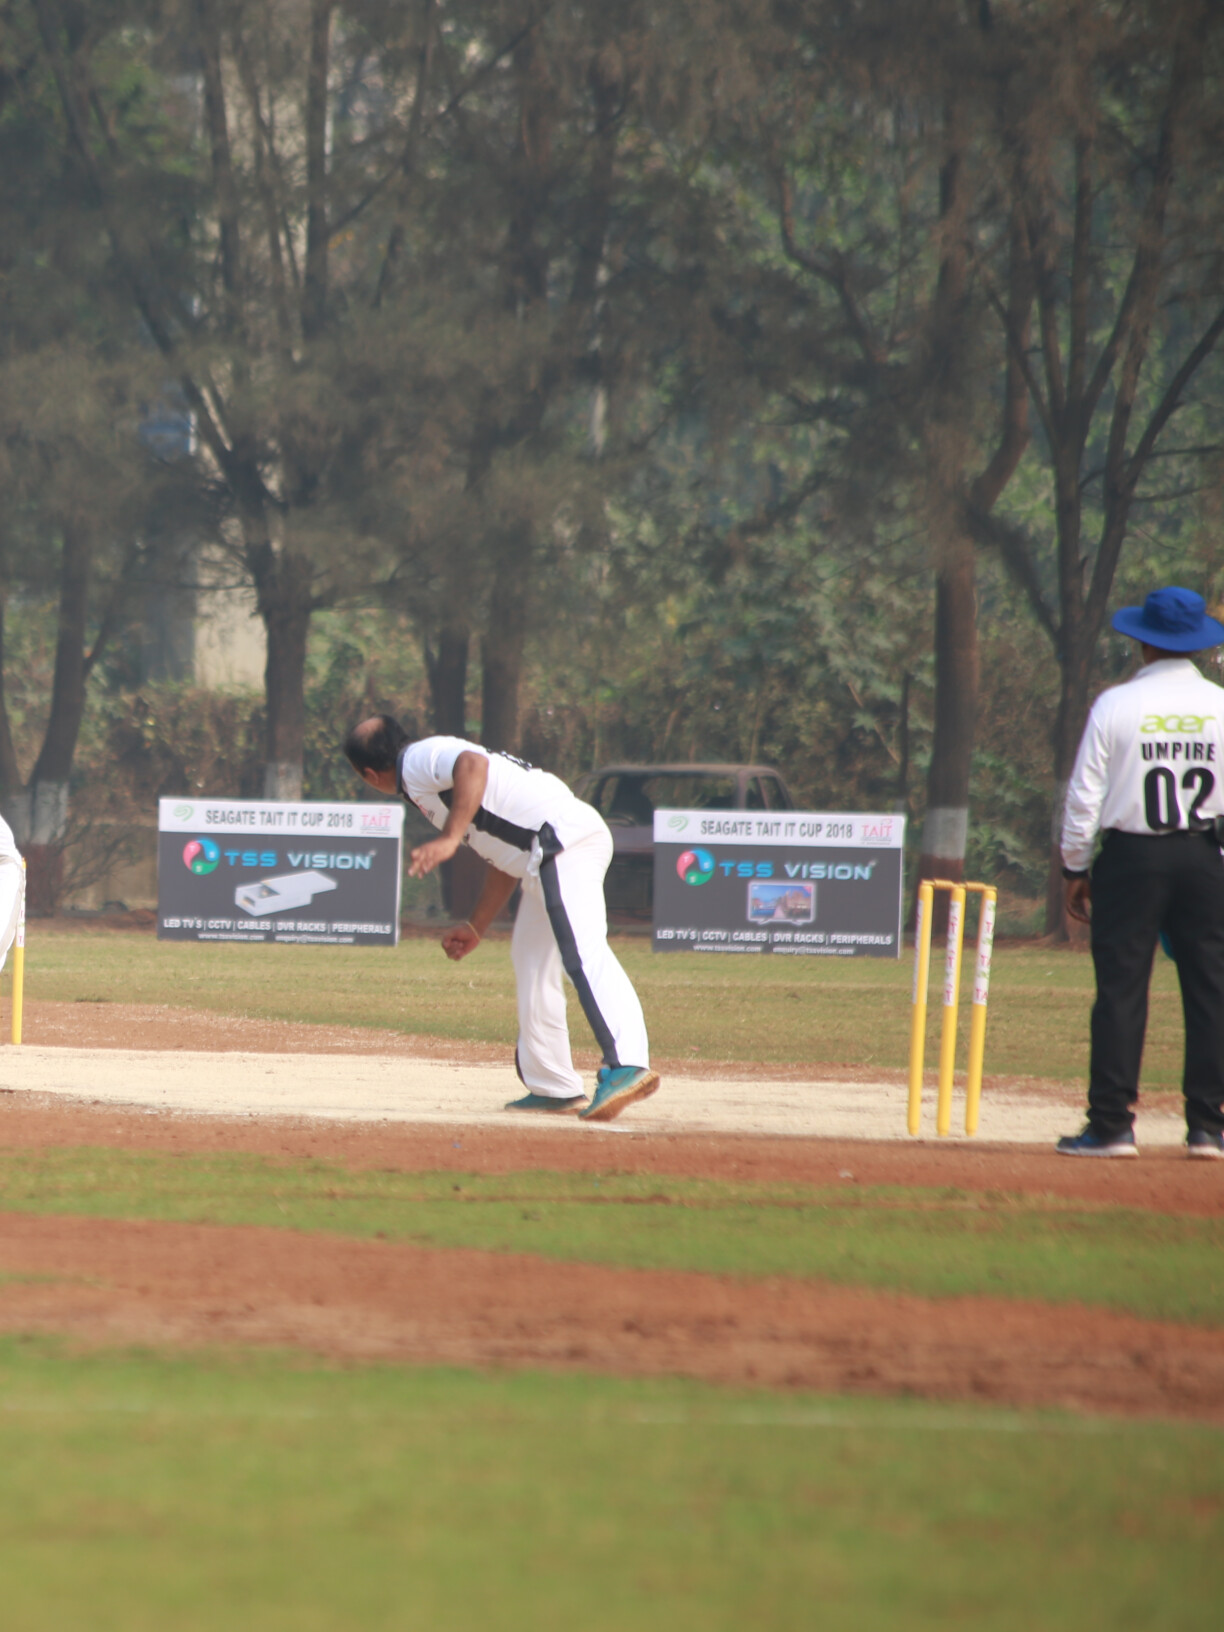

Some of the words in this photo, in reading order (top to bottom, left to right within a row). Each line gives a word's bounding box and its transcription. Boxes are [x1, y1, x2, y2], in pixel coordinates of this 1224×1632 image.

[1140, 715, 1216, 733] acer
[1144, 767, 1215, 831] 02
[205, 810, 255, 825] SEAGATE
[259, 811, 284, 826] TAIT
[287, 812, 298, 826] IT
[301, 812, 323, 827] CUP
[327, 813, 353, 828] 2018
[361, 814, 391, 826] TAIT
[700, 819, 752, 835] SEAGATE
[757, 822, 781, 836] TAIT
[784, 822, 795, 836] IT
[799, 823, 822, 837] CUP
[826, 823, 853, 839] 2018
[861, 824, 892, 837] TAIT
[225, 851, 277, 867] TSS
[720, 861, 774, 878] TSS
[163, 919, 181, 929] LED
[208, 920, 232, 930] CCTV
[237, 920, 271, 931] CABLES
[296, 922, 326, 932] RACKS
[332, 923, 392, 935] PERIPHERALS
[657, 930, 674, 939] LED
[702, 931, 726, 941] CCTV
[733, 932, 767, 942] CABLES
[794, 933, 823, 943] RACKS
[831, 934, 892, 945] PERIPHERALS
